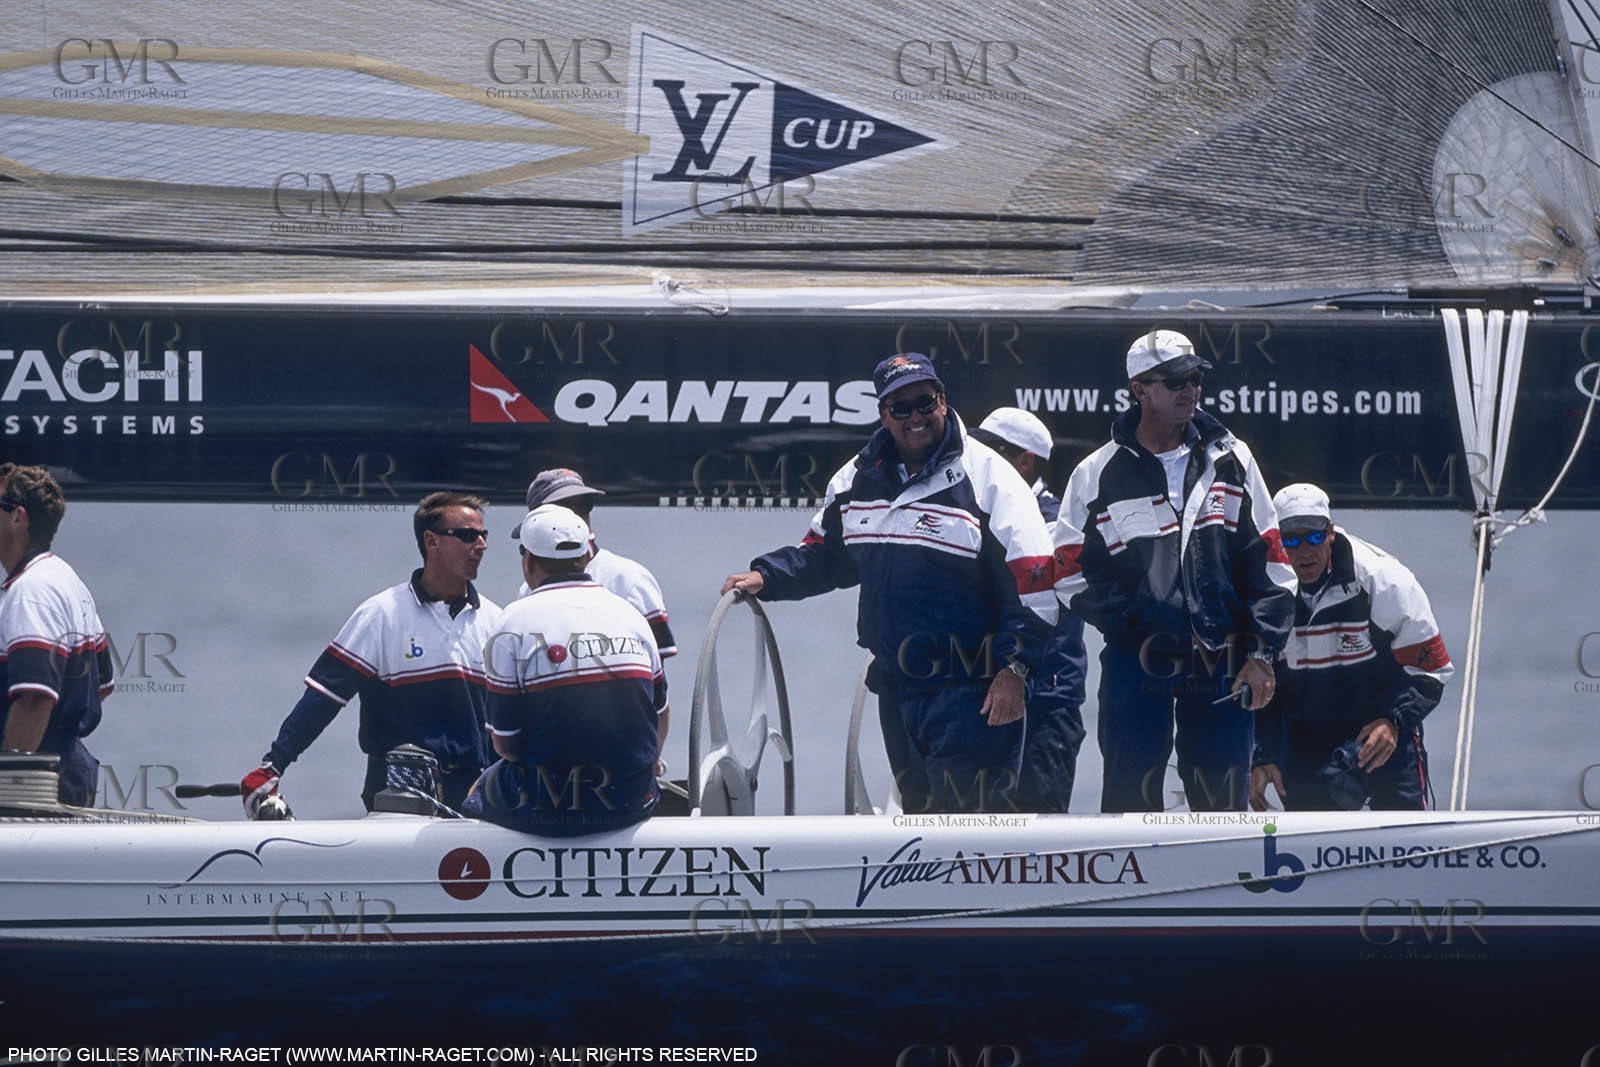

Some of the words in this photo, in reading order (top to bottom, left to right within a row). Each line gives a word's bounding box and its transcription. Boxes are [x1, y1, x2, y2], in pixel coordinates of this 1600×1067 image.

[783, 117, 875, 149] CUP
[0, 349, 203, 402] ACHI
[554, 379, 880, 426] QANTAS
[1016, 381, 1421, 421] www.s-stripes.com
[5, 415, 204, 435] SYSTEMS
[569, 637, 645, 660] CITIZE
[503, 846, 770, 898] CITIZEN
[942, 850, 1148, 884] AMERICA
[1311, 846, 1384, 869] JOHN
[1392, 846, 1469, 869] BOYLE
[1476, 846, 1494, 868] &
[1501, 845, 1546, 868] CO.
